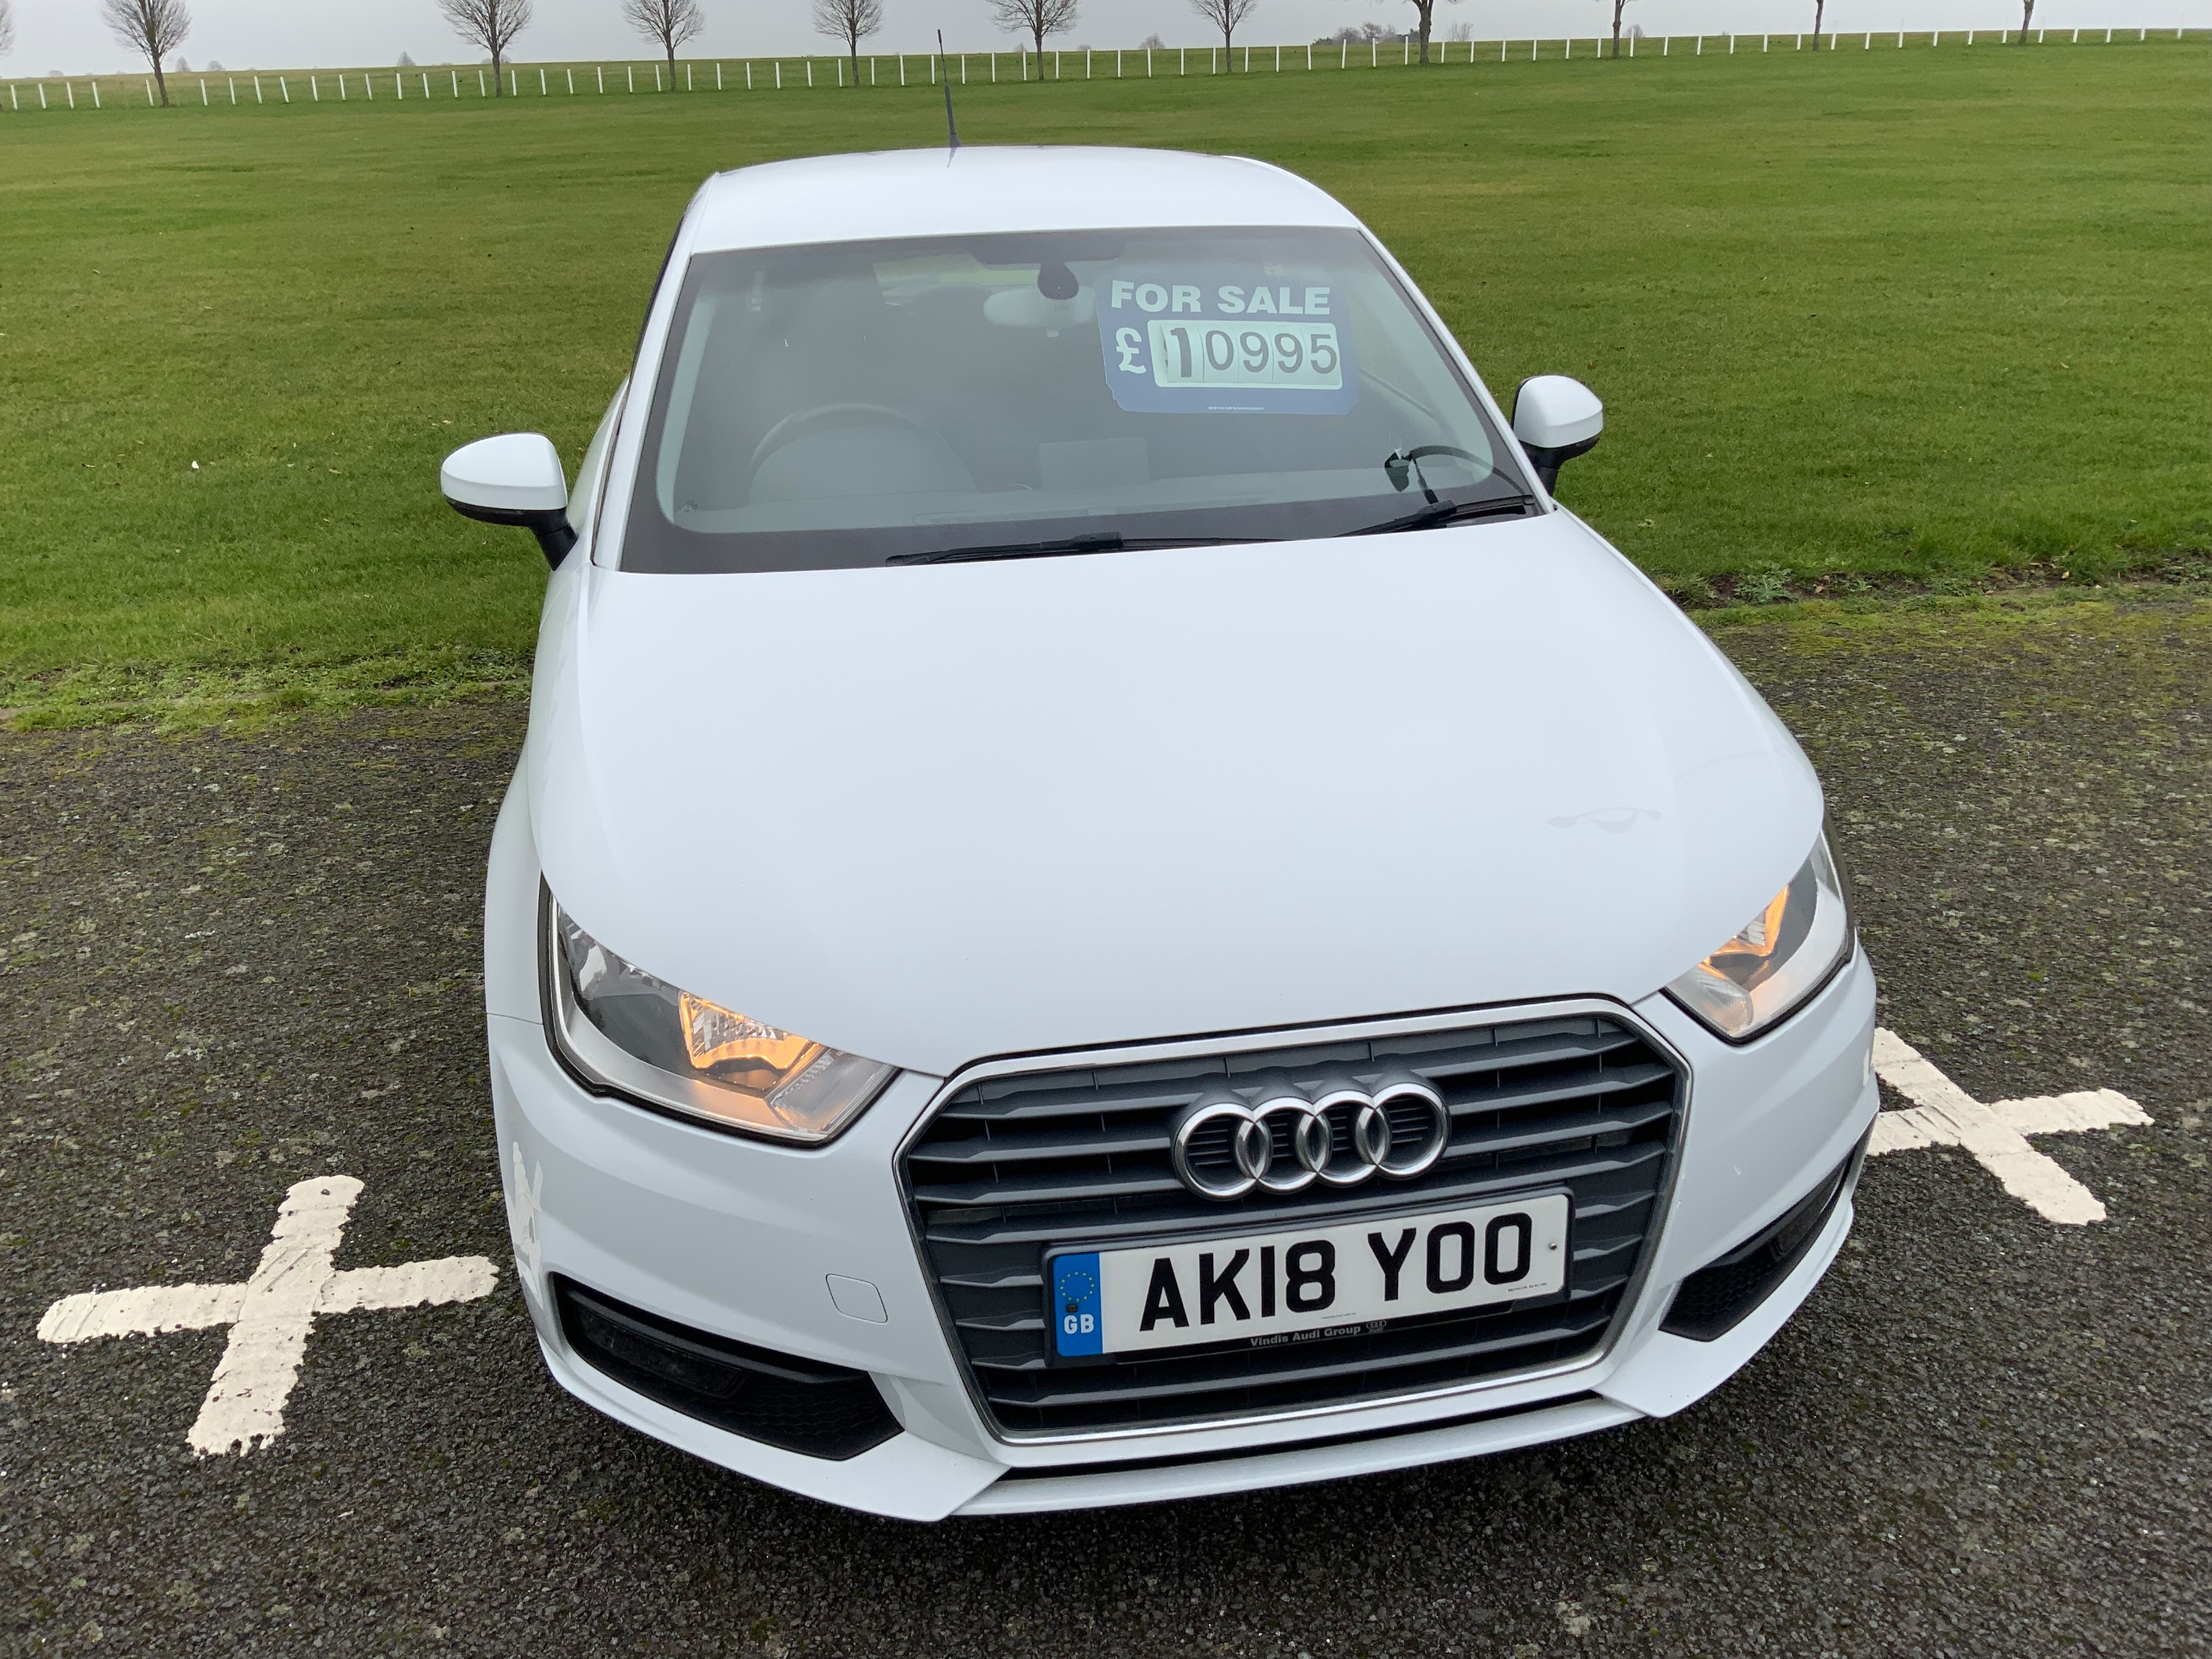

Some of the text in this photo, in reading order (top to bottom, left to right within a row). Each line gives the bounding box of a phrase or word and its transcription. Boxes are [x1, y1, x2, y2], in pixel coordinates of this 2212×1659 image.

[1111, 280, 1330, 315] FOR SALE
[1116, 327, 1338, 378] £ 10995
[1139, 1212, 1532, 1332] AK18 YOO
[1064, 1313, 1094, 1334] GB
[1250, 1325, 1361, 1346] Vindis Audi Group
